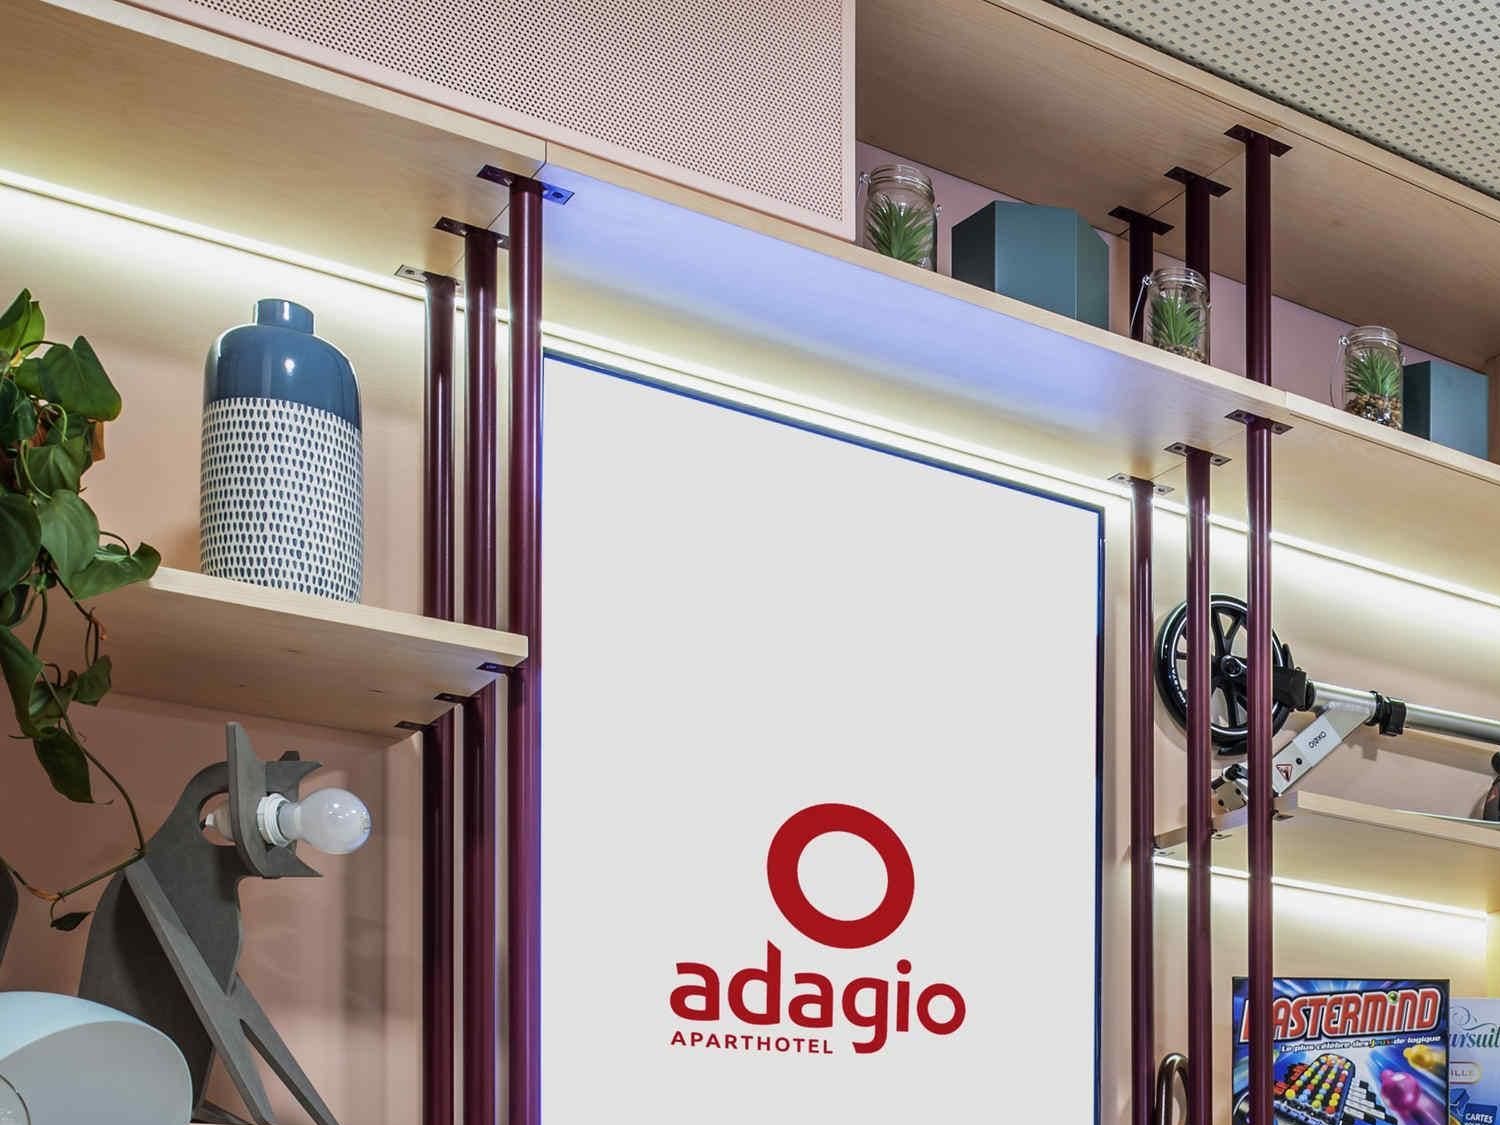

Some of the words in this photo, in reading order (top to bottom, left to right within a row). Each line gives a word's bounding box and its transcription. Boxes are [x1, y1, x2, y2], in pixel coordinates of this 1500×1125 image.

[669, 939, 967, 1054] adagio
[670, 1030, 834, 1055] APARTHOTEL
[1465, 1112, 1493, 1123] CARTES
